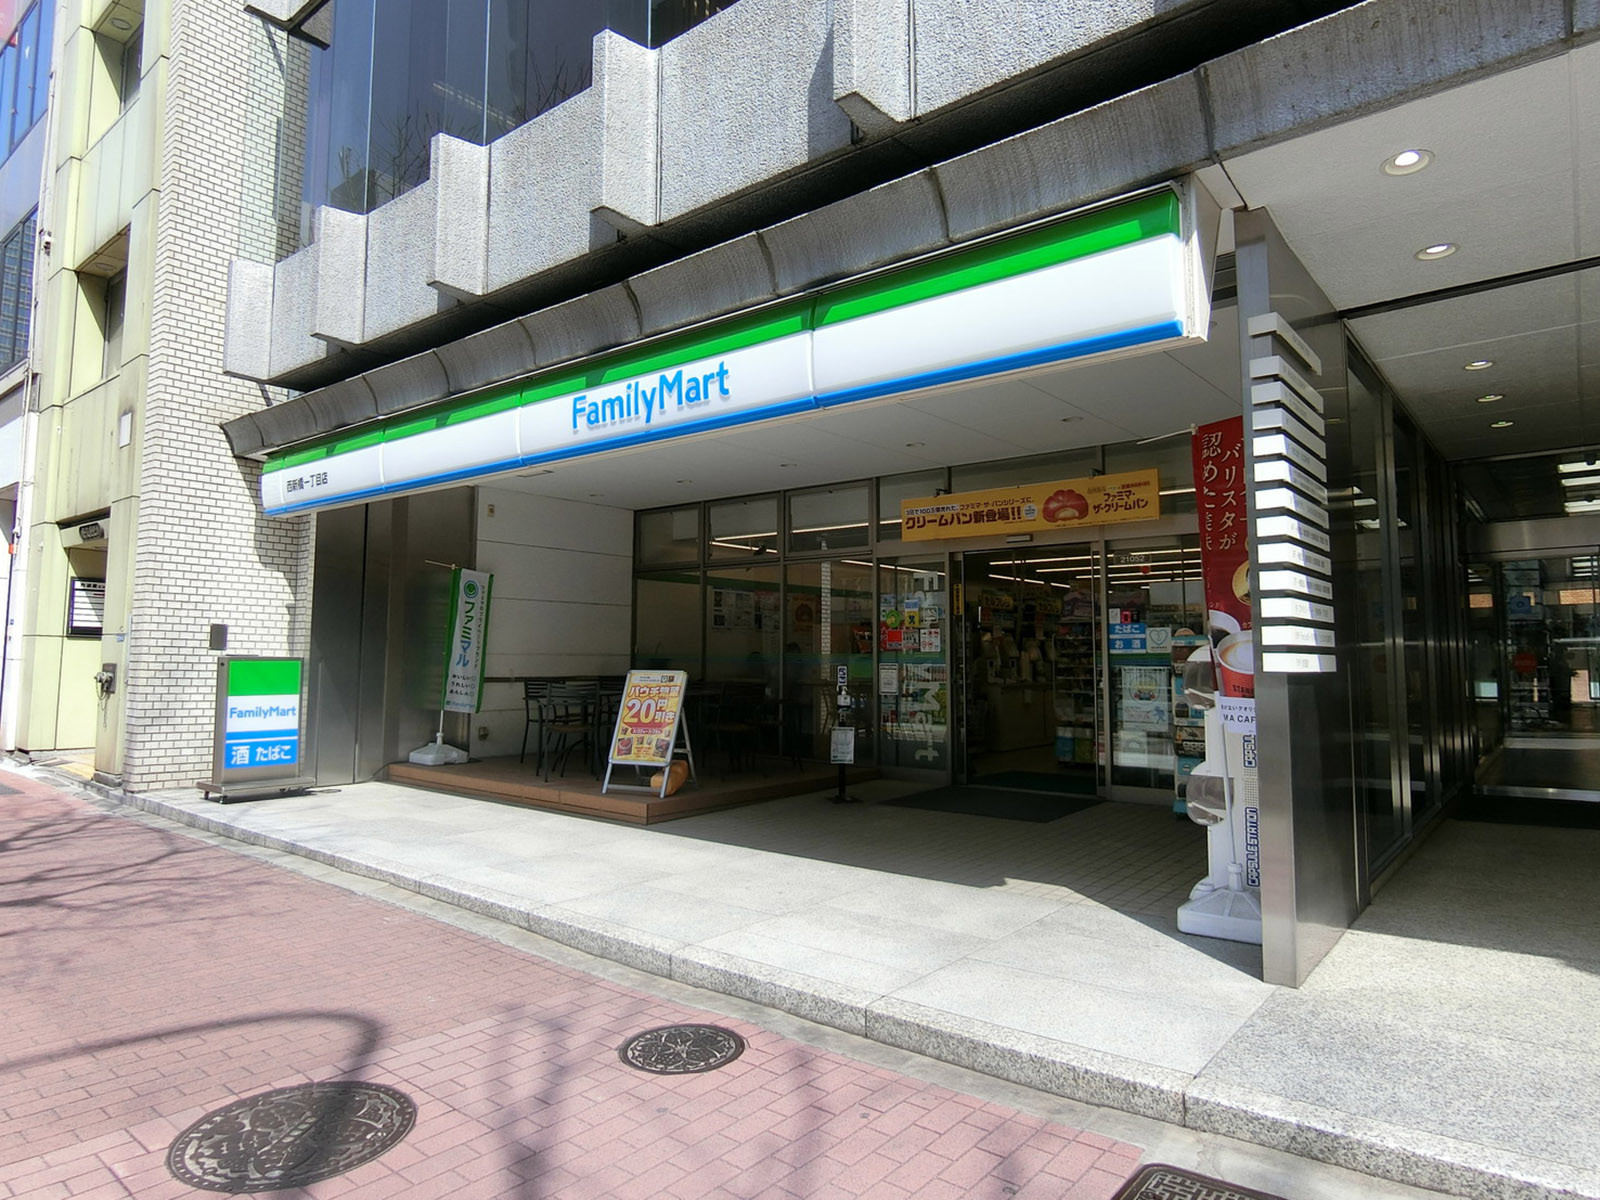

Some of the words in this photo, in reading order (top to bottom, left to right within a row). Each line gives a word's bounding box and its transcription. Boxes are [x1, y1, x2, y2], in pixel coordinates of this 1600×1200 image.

[572, 361, 730, 430] FamilyMart
[287, 471, 328, 493] 西新橋一丁目店
[1218, 443, 1242, 551] バリスタが
[1120, 555, 1145, 563] 21052
[456, 601, 475, 668] ファミマル
[1114, 625, 1140, 634] たばこ
[229, 706, 296, 719] FamilyMart
[231, 745, 250, 765] 酒
[255, 745, 292, 762] たばこ
